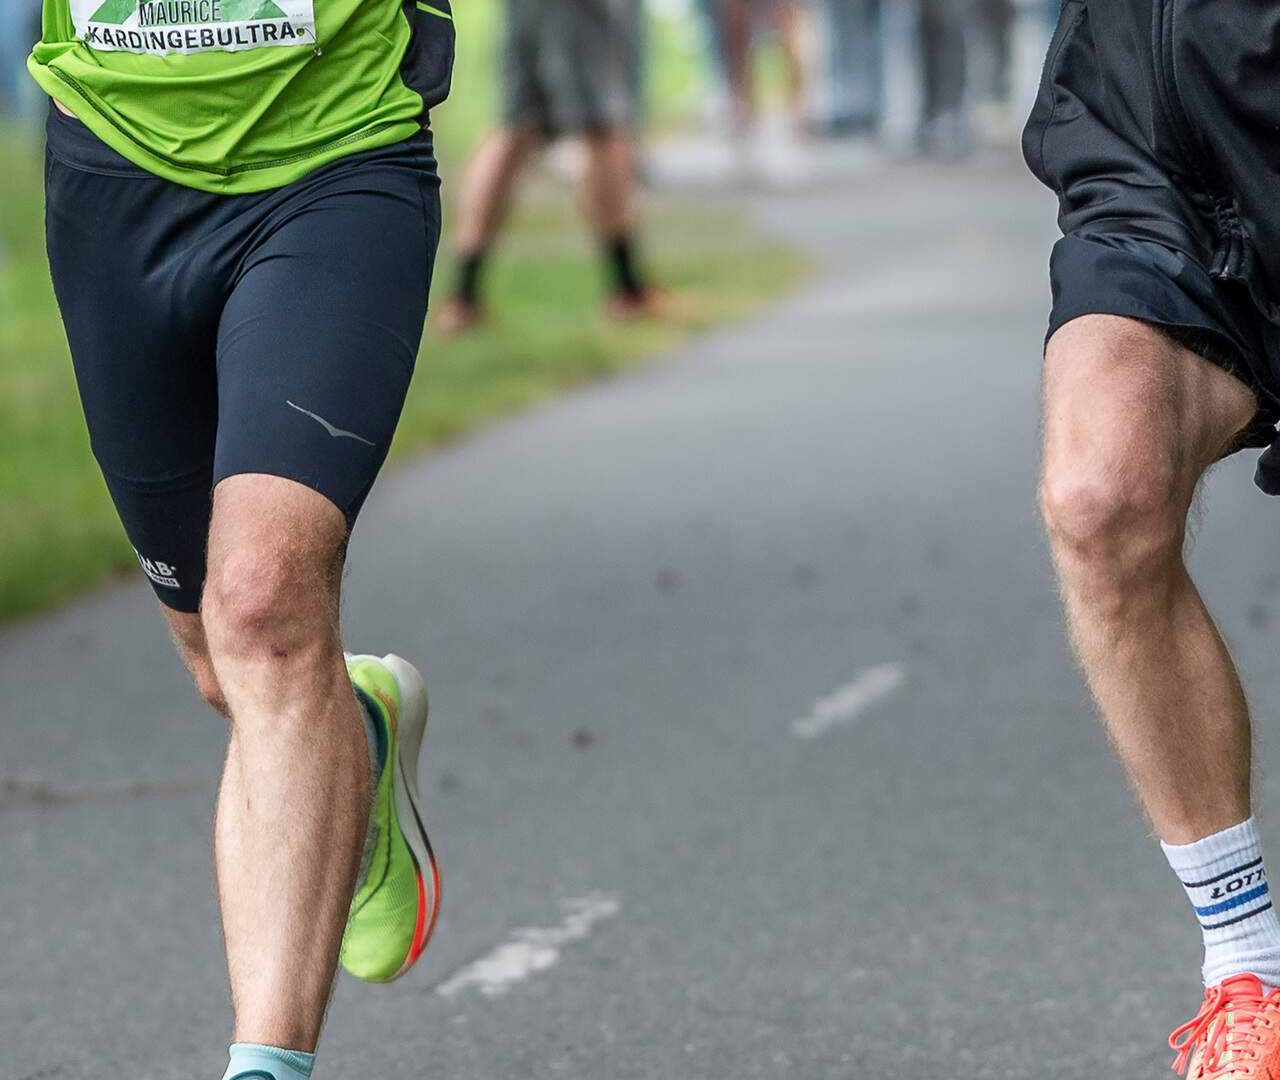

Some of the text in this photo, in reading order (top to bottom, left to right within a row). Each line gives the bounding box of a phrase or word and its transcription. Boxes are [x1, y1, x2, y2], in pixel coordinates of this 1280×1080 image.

[140, 0, 222, 26] MAURICE
[88, 21, 296, 50] KARDINGEBULTRA
[1211, 868, 1266, 899] LOTT
